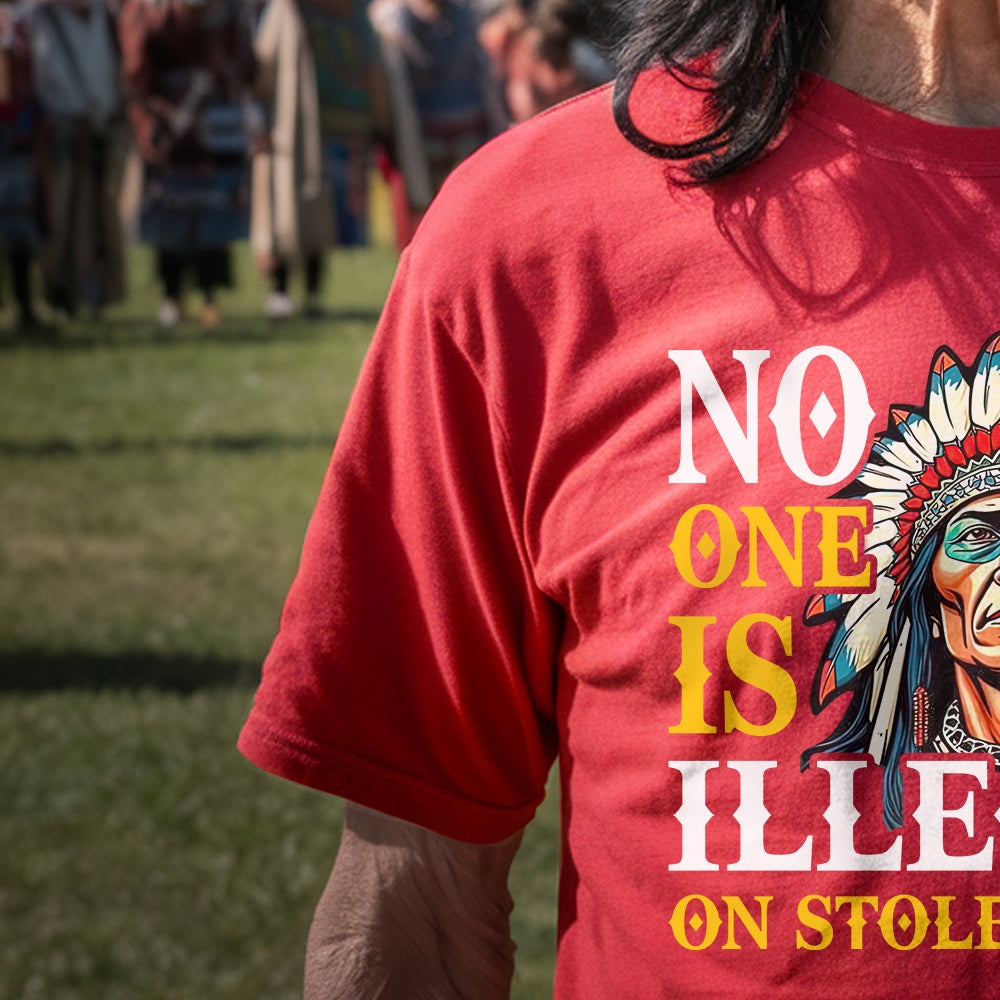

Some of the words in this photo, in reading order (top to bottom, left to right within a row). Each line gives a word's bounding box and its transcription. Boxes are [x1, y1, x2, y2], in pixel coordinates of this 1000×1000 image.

[668, 345, 876, 486] NO
[669, 504, 871, 588] ONE
[668, 612, 797, 736] IS
[668, 894, 773, 950] ON
